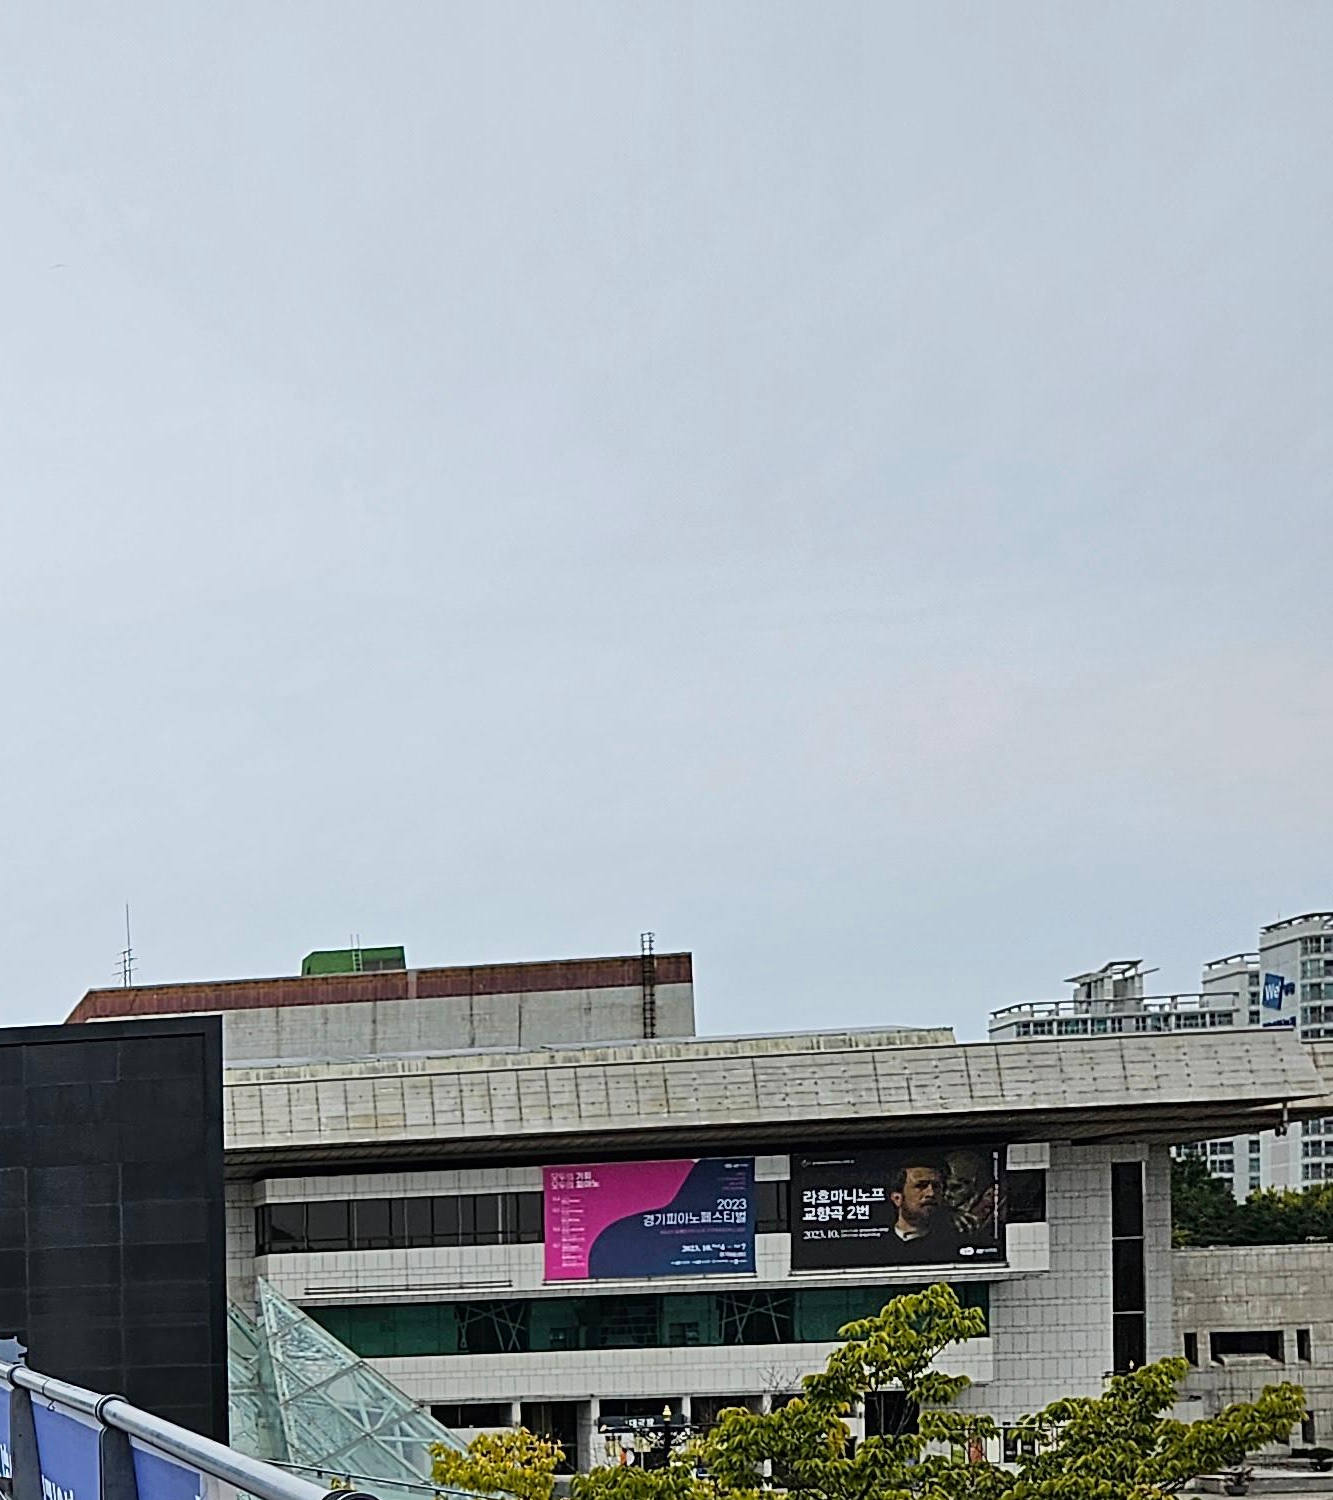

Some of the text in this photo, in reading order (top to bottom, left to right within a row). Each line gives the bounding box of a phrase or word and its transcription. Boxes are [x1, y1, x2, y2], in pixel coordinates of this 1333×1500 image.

[716, 1199, 748, 1211] 2023
[802, 1188, 886, 1206] 라흐마니노프
[643, 1211, 747, 1228] 경기피아노페스티벌
[802, 1204, 870, 1222] 교향곡 2번
